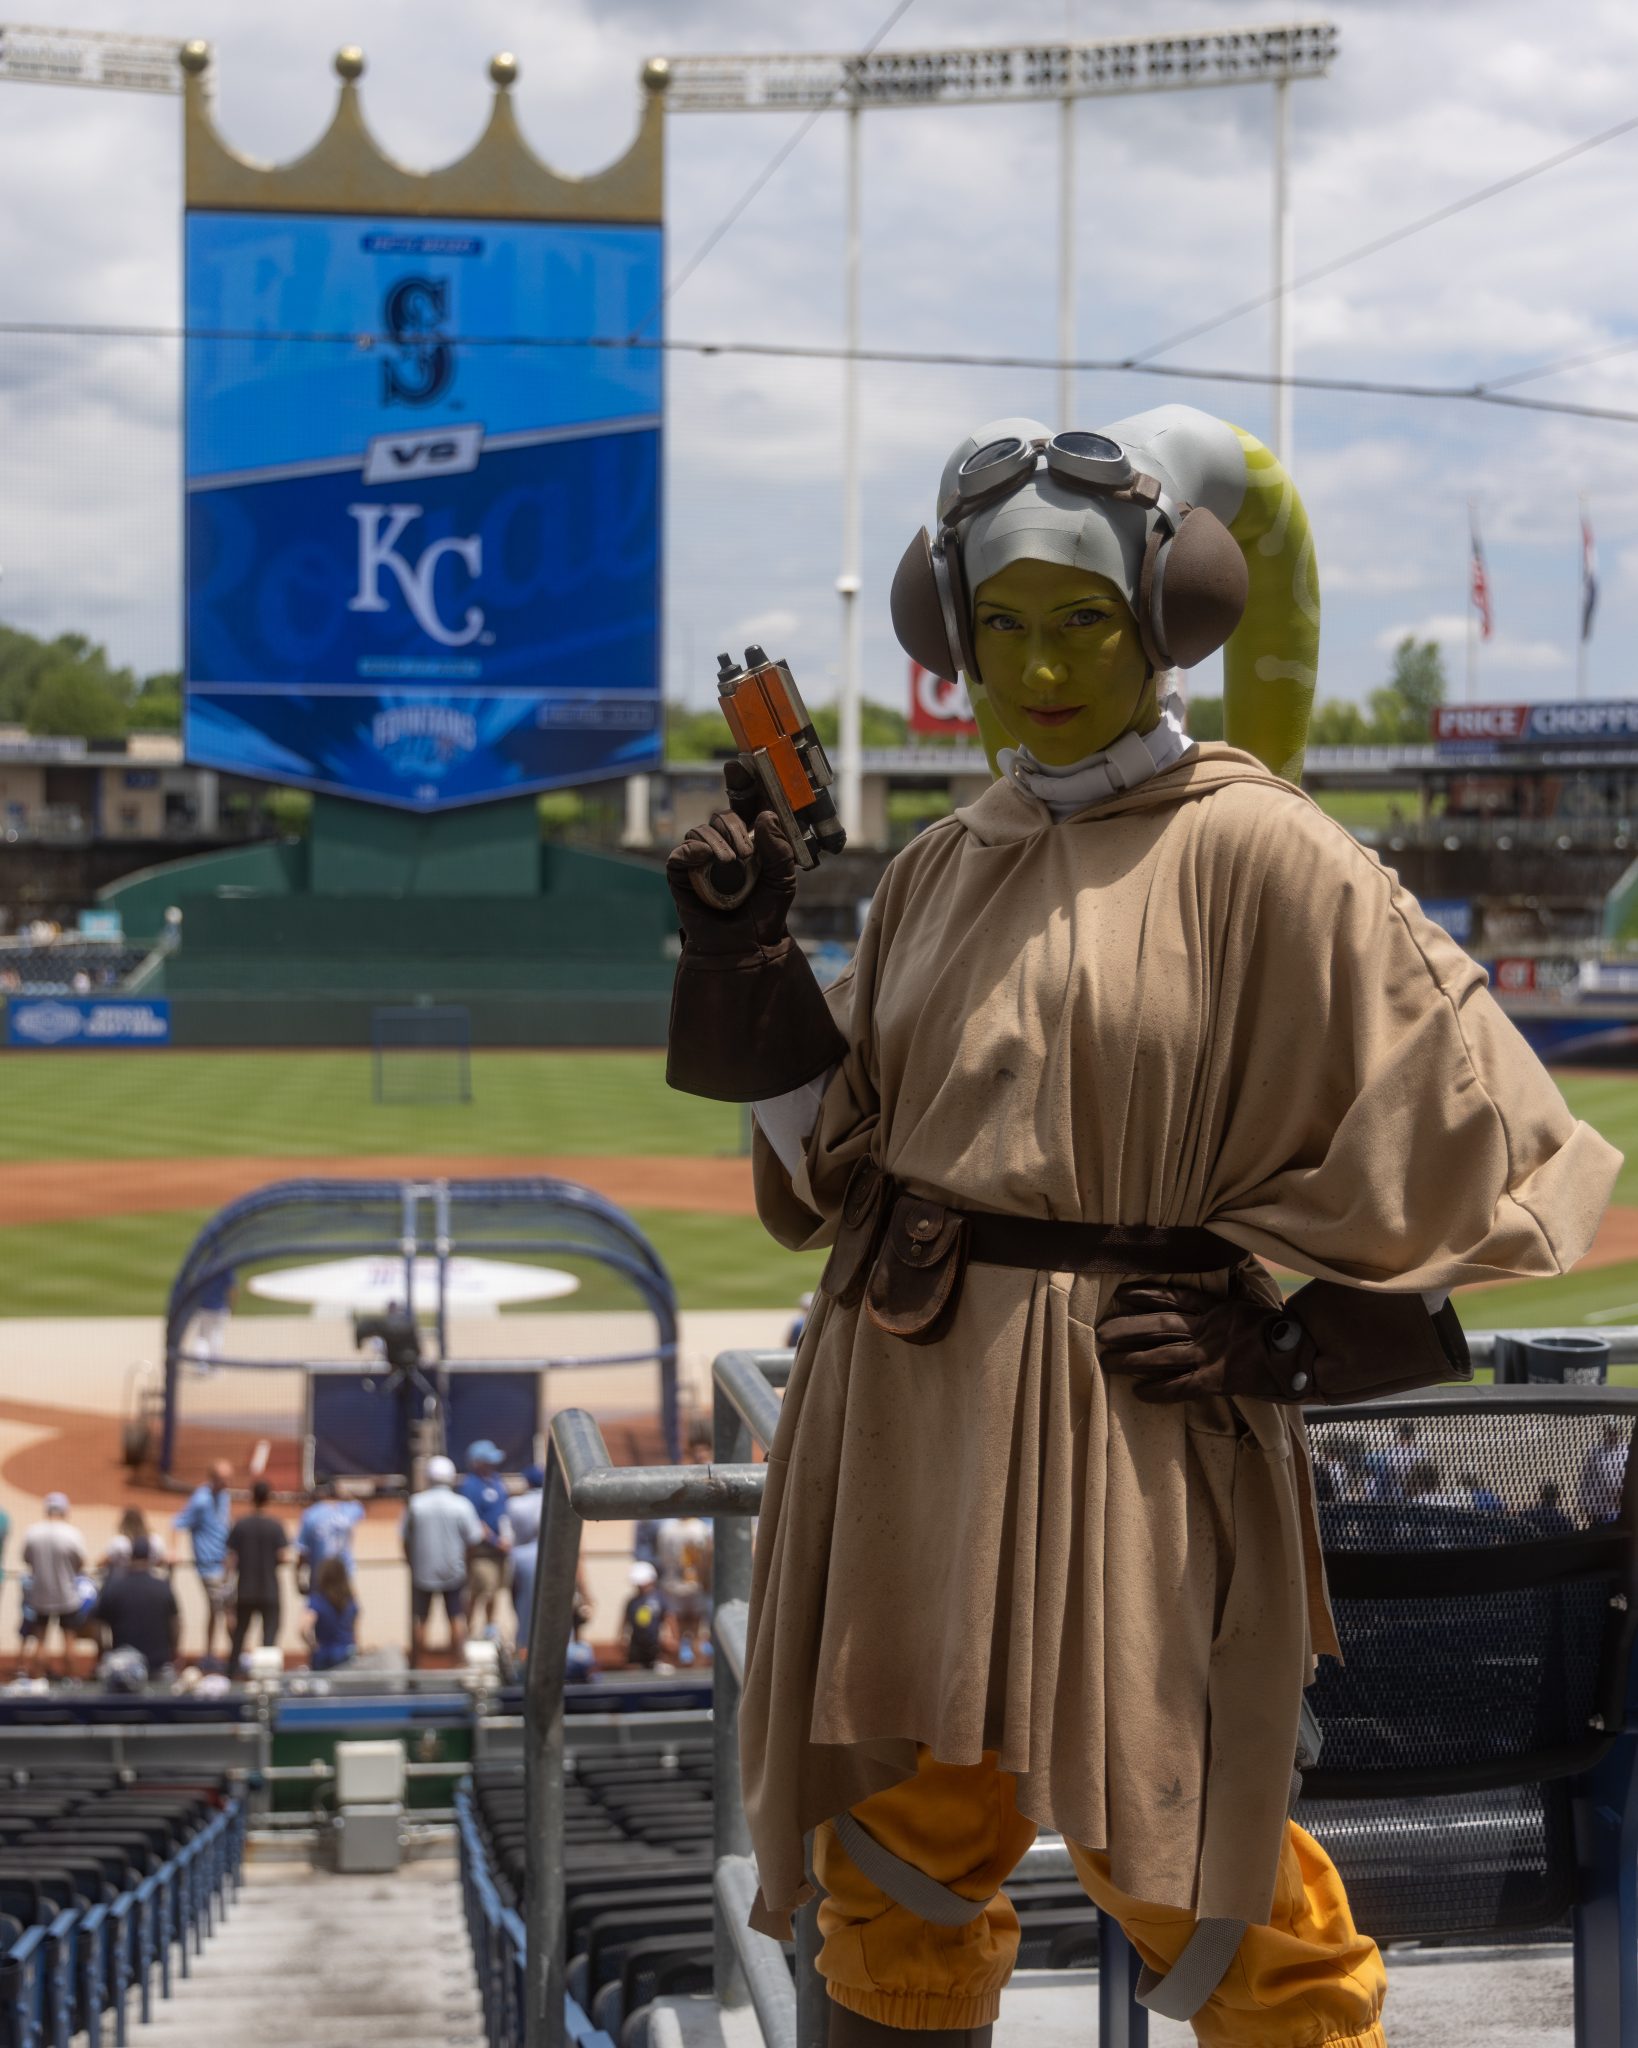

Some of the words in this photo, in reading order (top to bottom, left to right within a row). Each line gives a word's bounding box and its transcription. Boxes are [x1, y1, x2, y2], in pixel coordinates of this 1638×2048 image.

[380, 275, 455, 408] S
[347, 502, 485, 647] KC
[1439, 710, 1516, 736] PRICE
